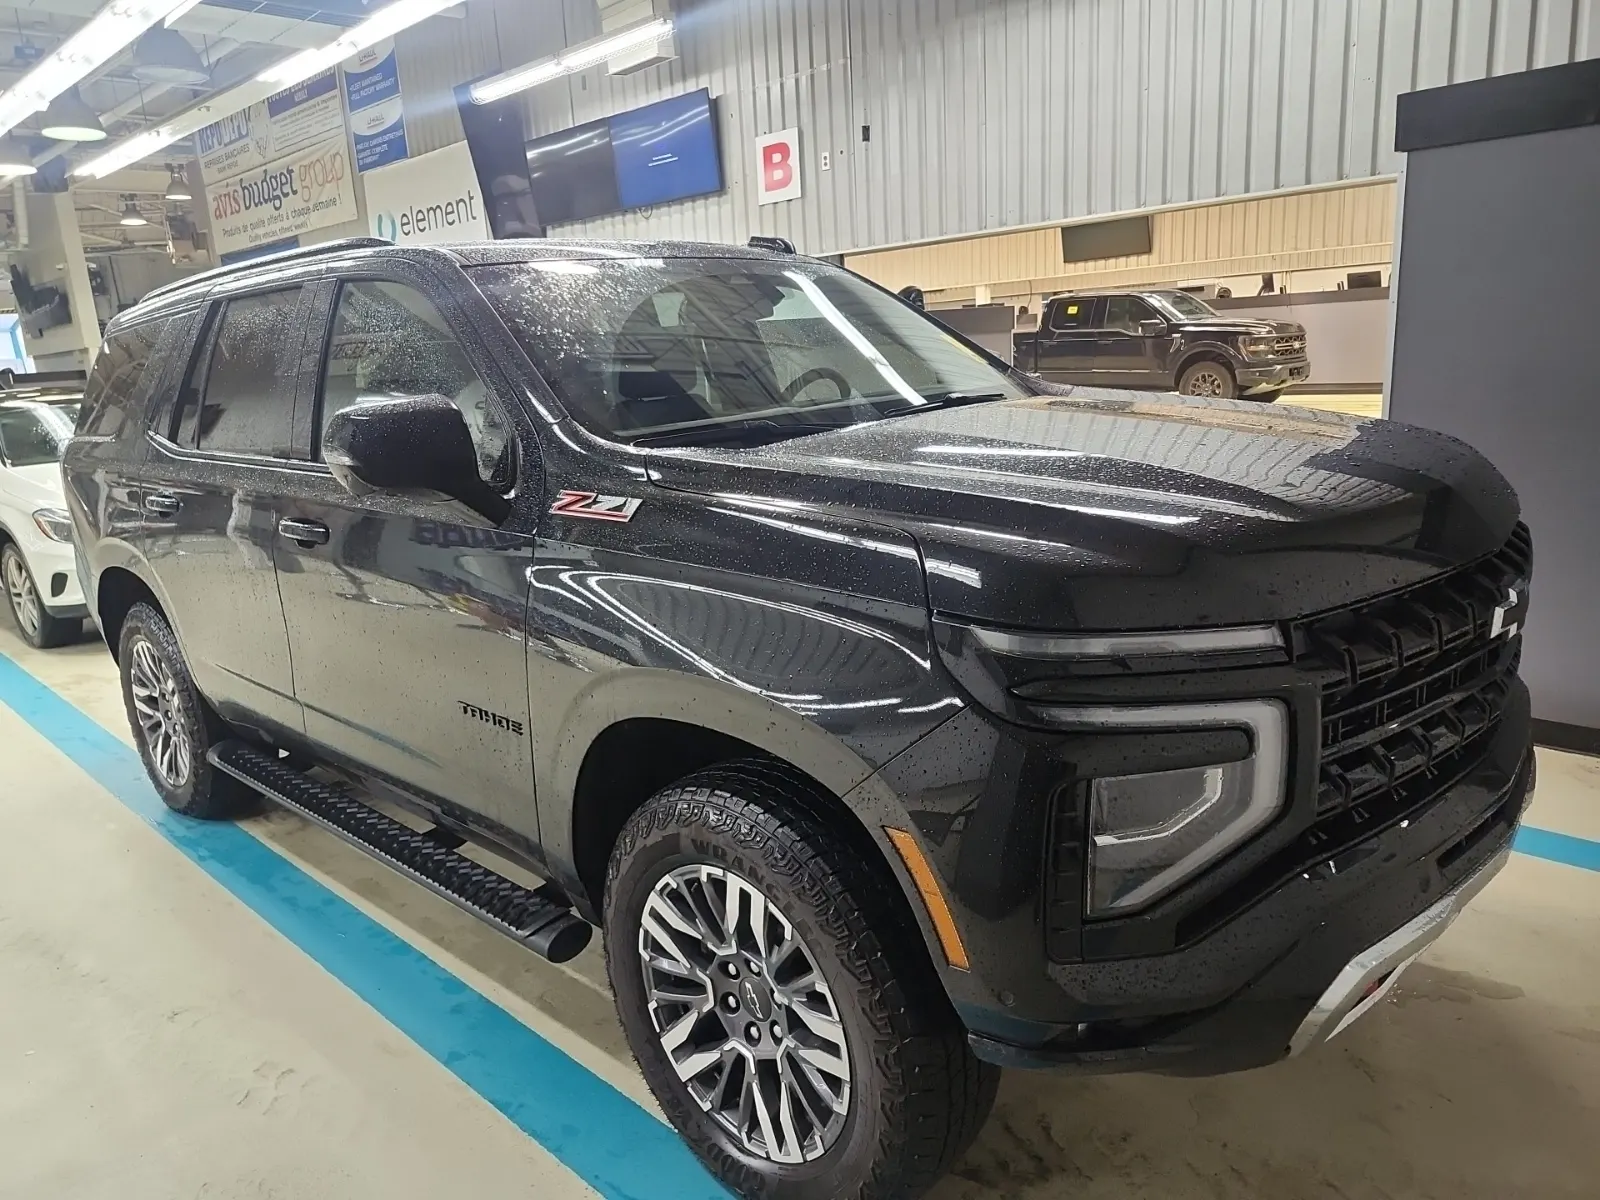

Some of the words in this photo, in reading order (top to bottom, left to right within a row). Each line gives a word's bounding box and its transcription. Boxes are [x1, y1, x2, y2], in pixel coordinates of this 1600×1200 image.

[224, 143, 250, 161] BANCAIRES
[762, 141, 793, 192] B
[212, 182, 241, 220] avis
[239, 165, 299, 211] budget
[298, 151, 345, 203] group
[222, 226, 241, 239] Produits
[243, 223, 249, 233] de
[267, 212, 284, 226] offerts
[290, 204, 311, 219] chaque
[312, 197, 338, 213] semaine
[400, 190, 477, 237] element
[548, 489, 643, 522] Z71
